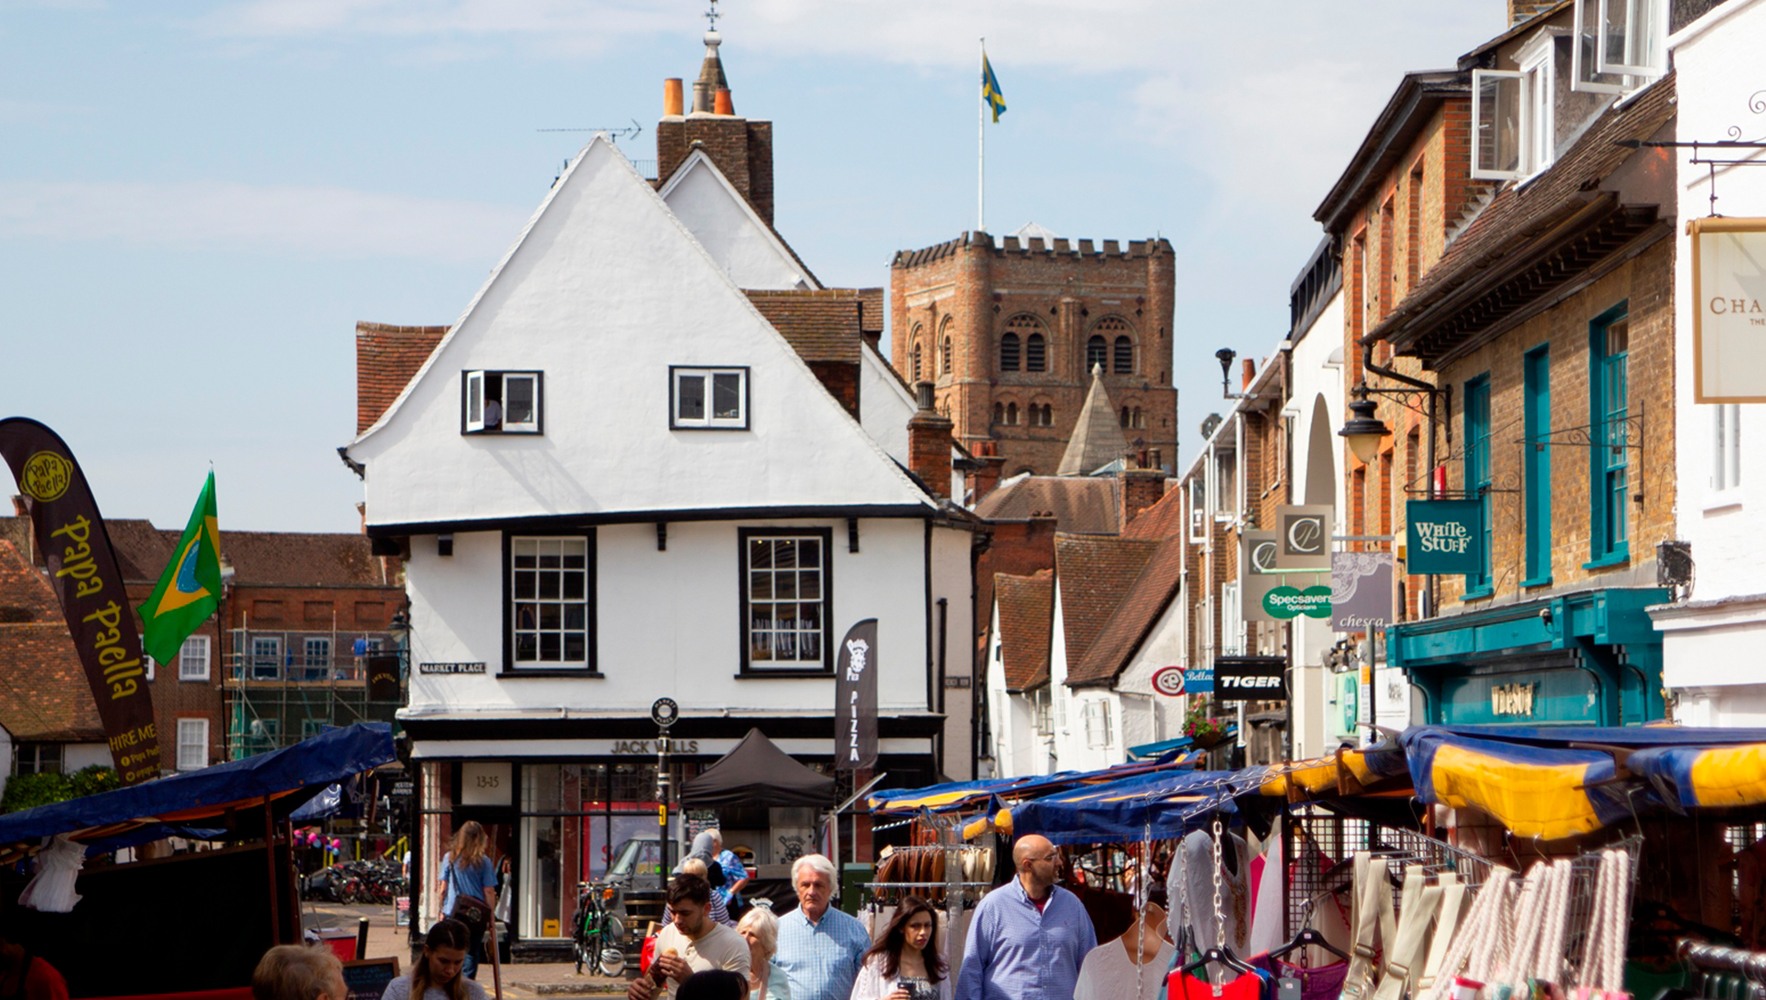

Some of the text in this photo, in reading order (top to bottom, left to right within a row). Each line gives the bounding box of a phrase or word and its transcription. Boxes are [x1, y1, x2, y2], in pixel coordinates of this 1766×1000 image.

[28, 459, 58, 480] Papa
[33, 474, 64, 493] Paella
[51, 514, 143, 700] Papa Paella
[1287, 603, 1317, 611] Opticians
[1340, 614, 1384, 627] chesca
[421, 663, 483, 673] MARKET PLACE
[1221, 676, 1281, 688] TIGER
[850, 690, 859, 761] PIZZA
[109, 723, 157, 752] HIRE ME
[611, 740, 649, 754] JACK
[476, 776, 499, 788] 13-15
